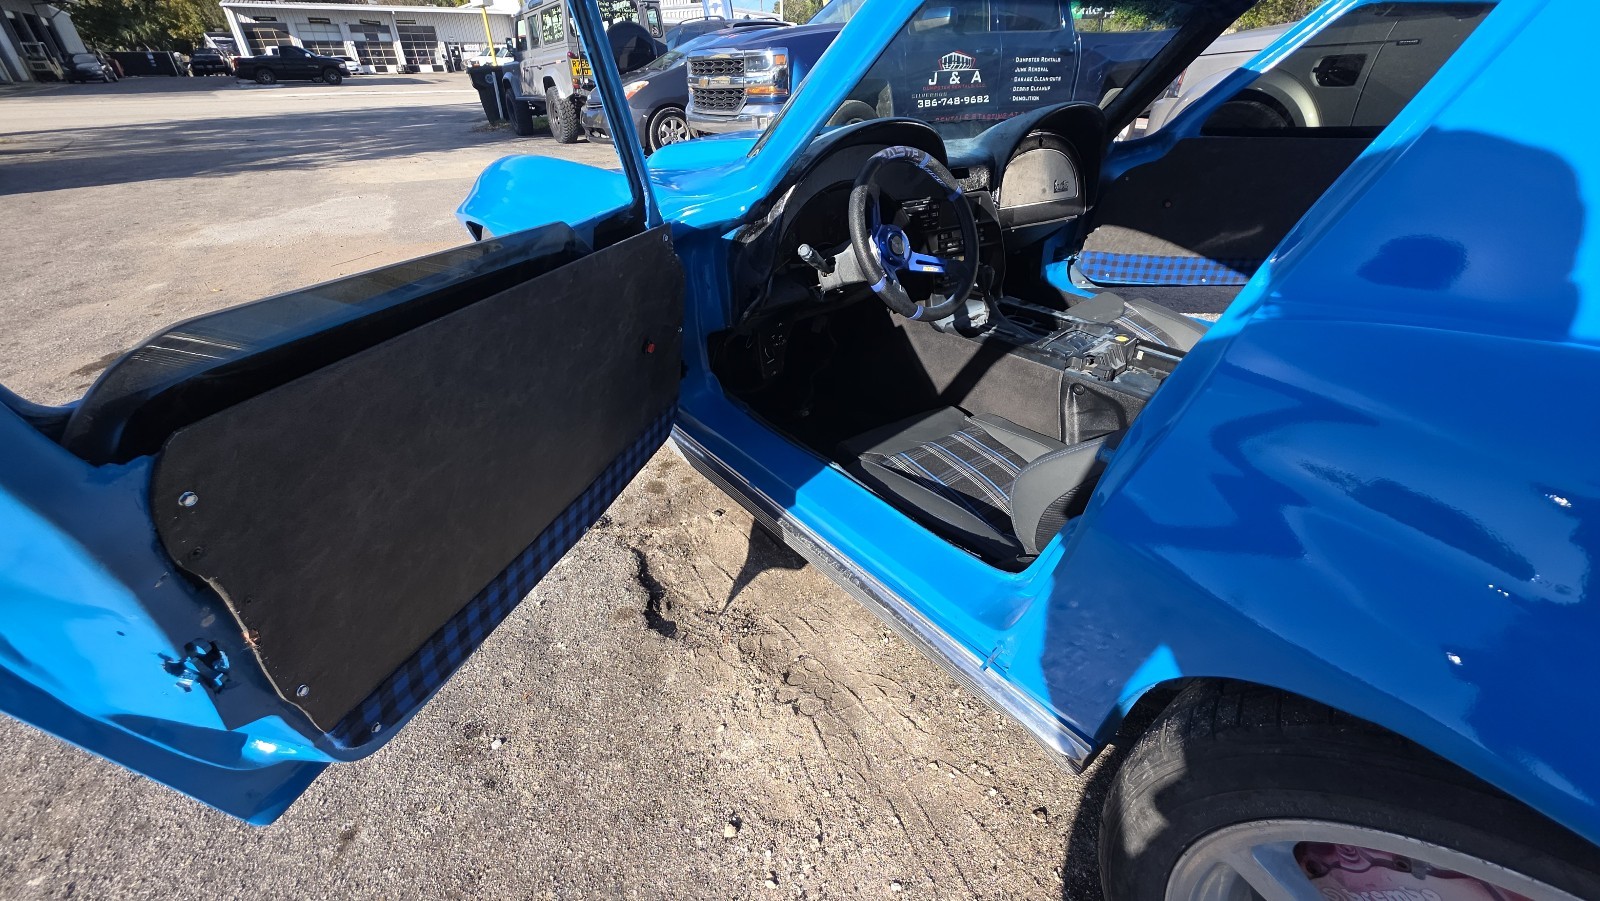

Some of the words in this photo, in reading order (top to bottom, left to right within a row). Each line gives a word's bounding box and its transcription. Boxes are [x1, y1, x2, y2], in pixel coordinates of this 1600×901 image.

[928, 72, 938, 86] J
[949, 72, 961, 85] &
[970, 70, 982, 84] A
[917, 94, 990, 108] 386-748-9682
